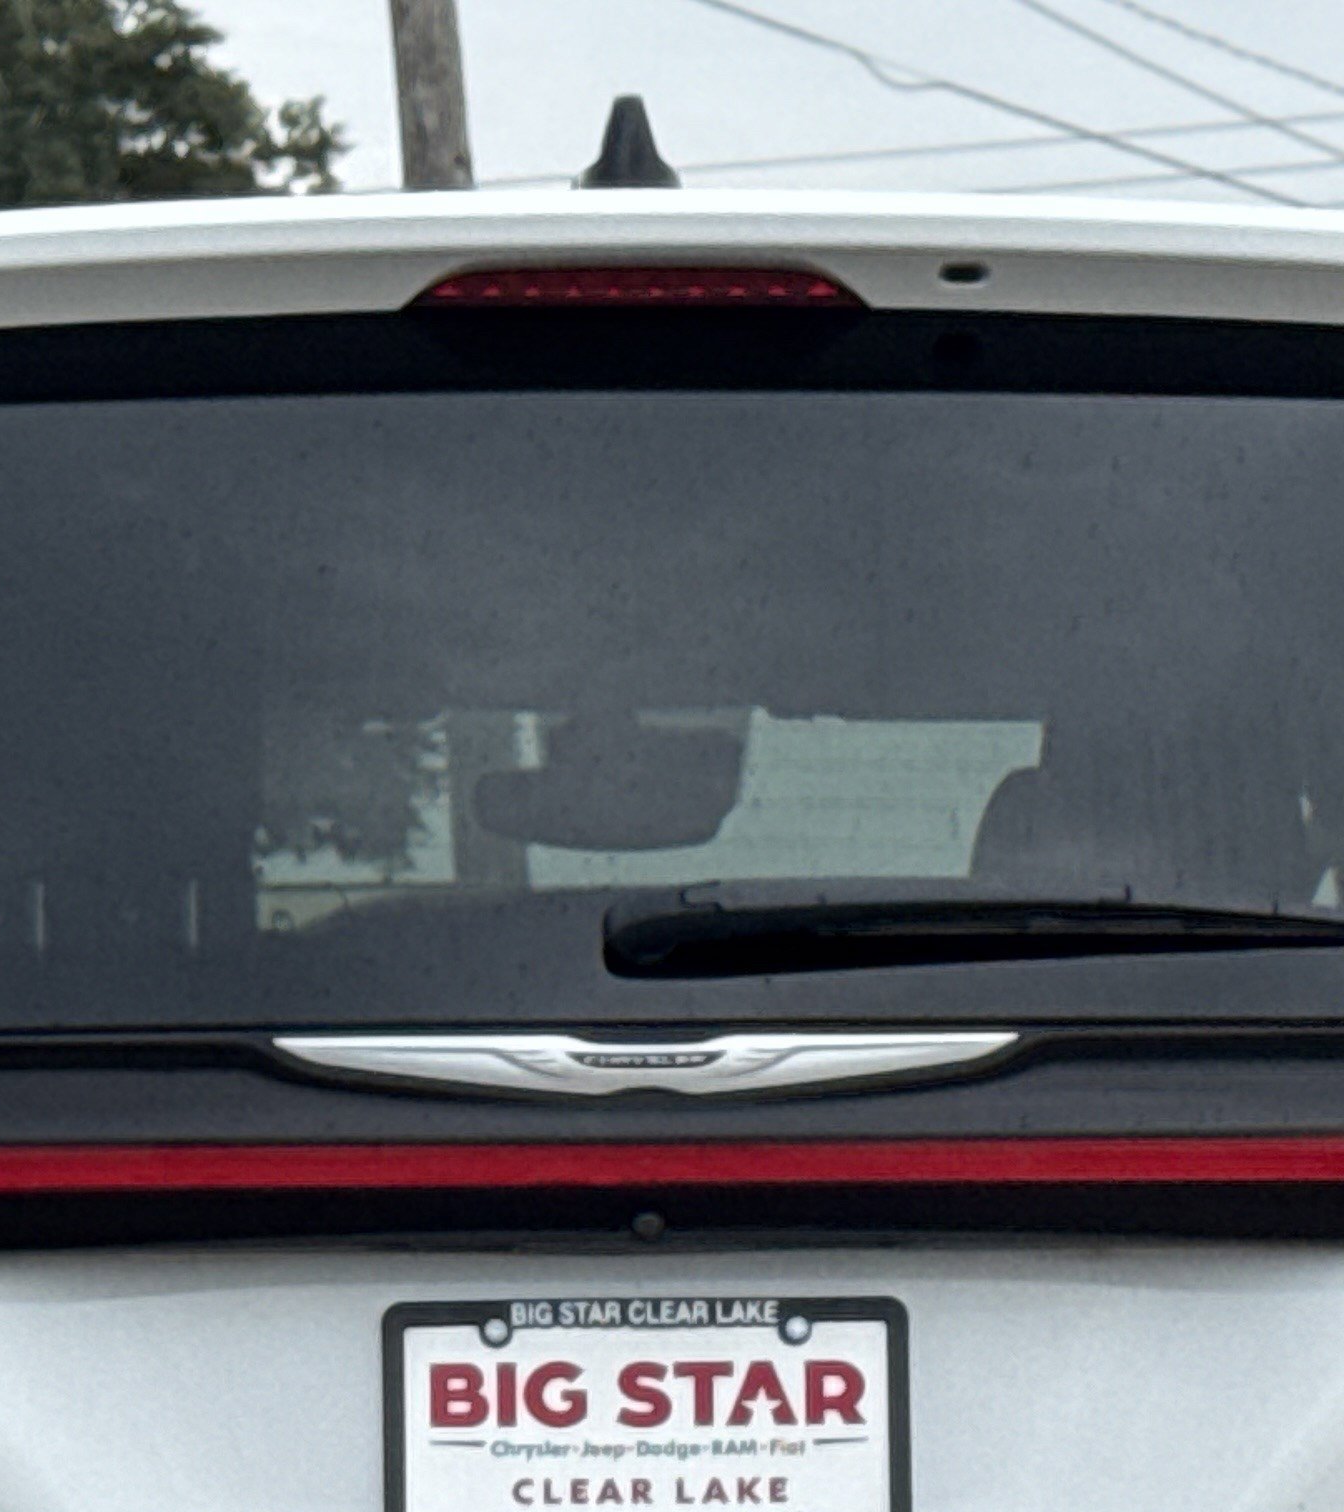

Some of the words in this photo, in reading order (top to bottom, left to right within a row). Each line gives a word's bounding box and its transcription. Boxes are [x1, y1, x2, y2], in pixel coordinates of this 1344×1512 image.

[510, 1302, 553, 1326] BIG
[558, 1301, 621, 1326] STAR
[628, 1301, 707, 1324] CLEAR
[715, 1300, 780, 1324] LAKE
[429, 1361, 588, 1428] BIG
[616, 1360, 867, 1428] STAR
[512, 1477, 654, 1505] CLEAR
[675, 1476, 790, 1504] LAKE
